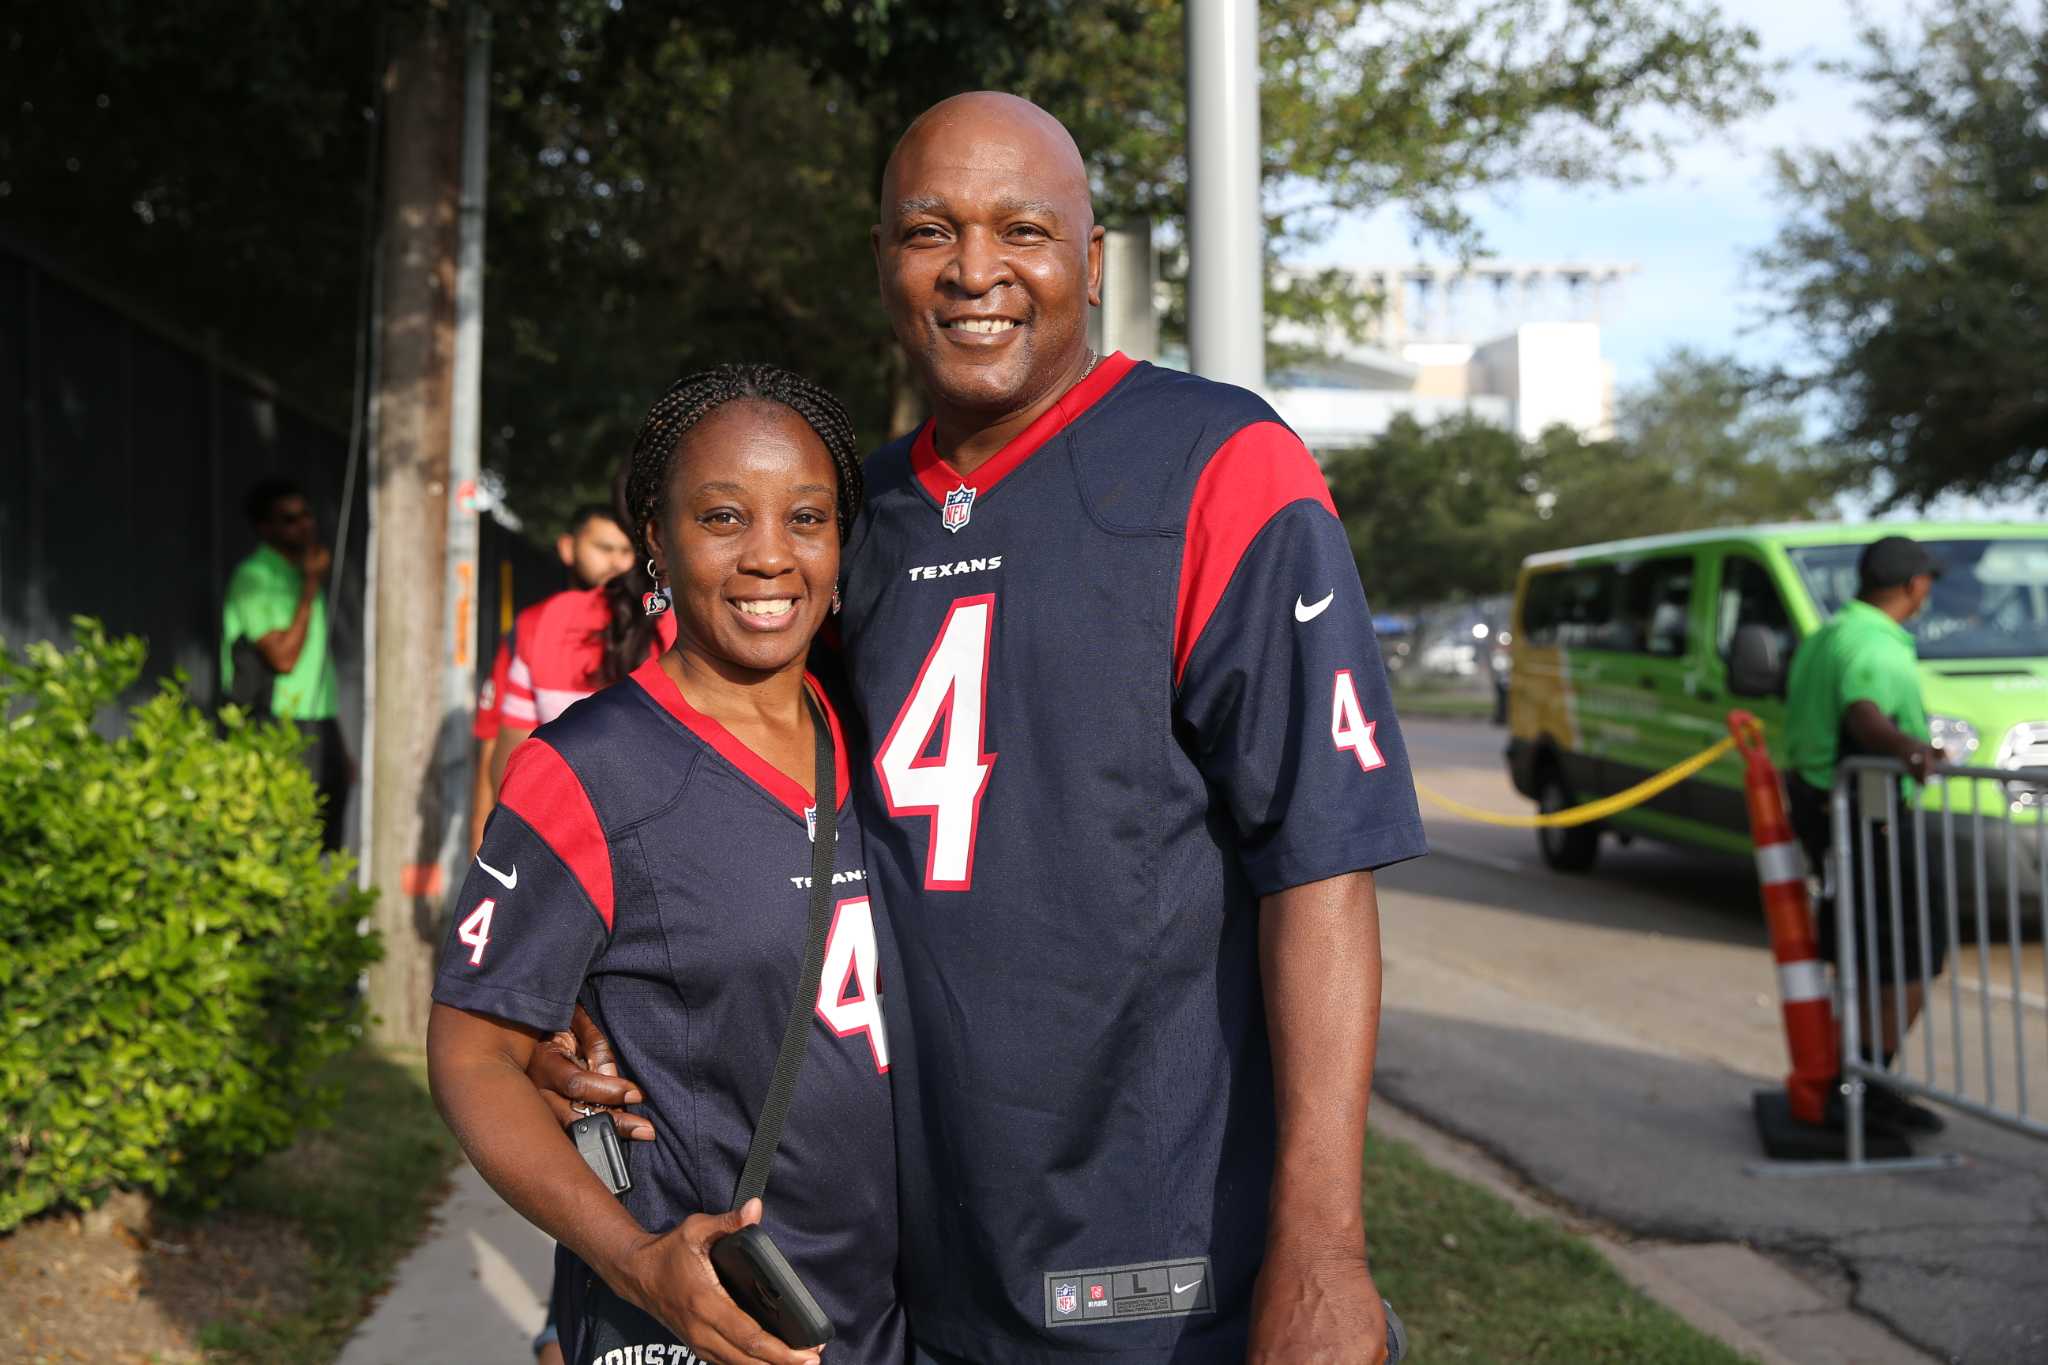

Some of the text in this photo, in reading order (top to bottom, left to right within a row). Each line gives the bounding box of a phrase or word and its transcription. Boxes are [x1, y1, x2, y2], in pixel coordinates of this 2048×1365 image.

[946, 504, 966, 523] NFL
[909, 556, 1002, 581] TEXANS
[873, 592, 998, 891] 4
[1332, 669, 1386, 772] 4
[790, 869, 867, 889] TEAN
[457, 897, 496, 967] 4
[815, 895, 889, 1075] 4
[1132, 1273, 1147, 1293] L
